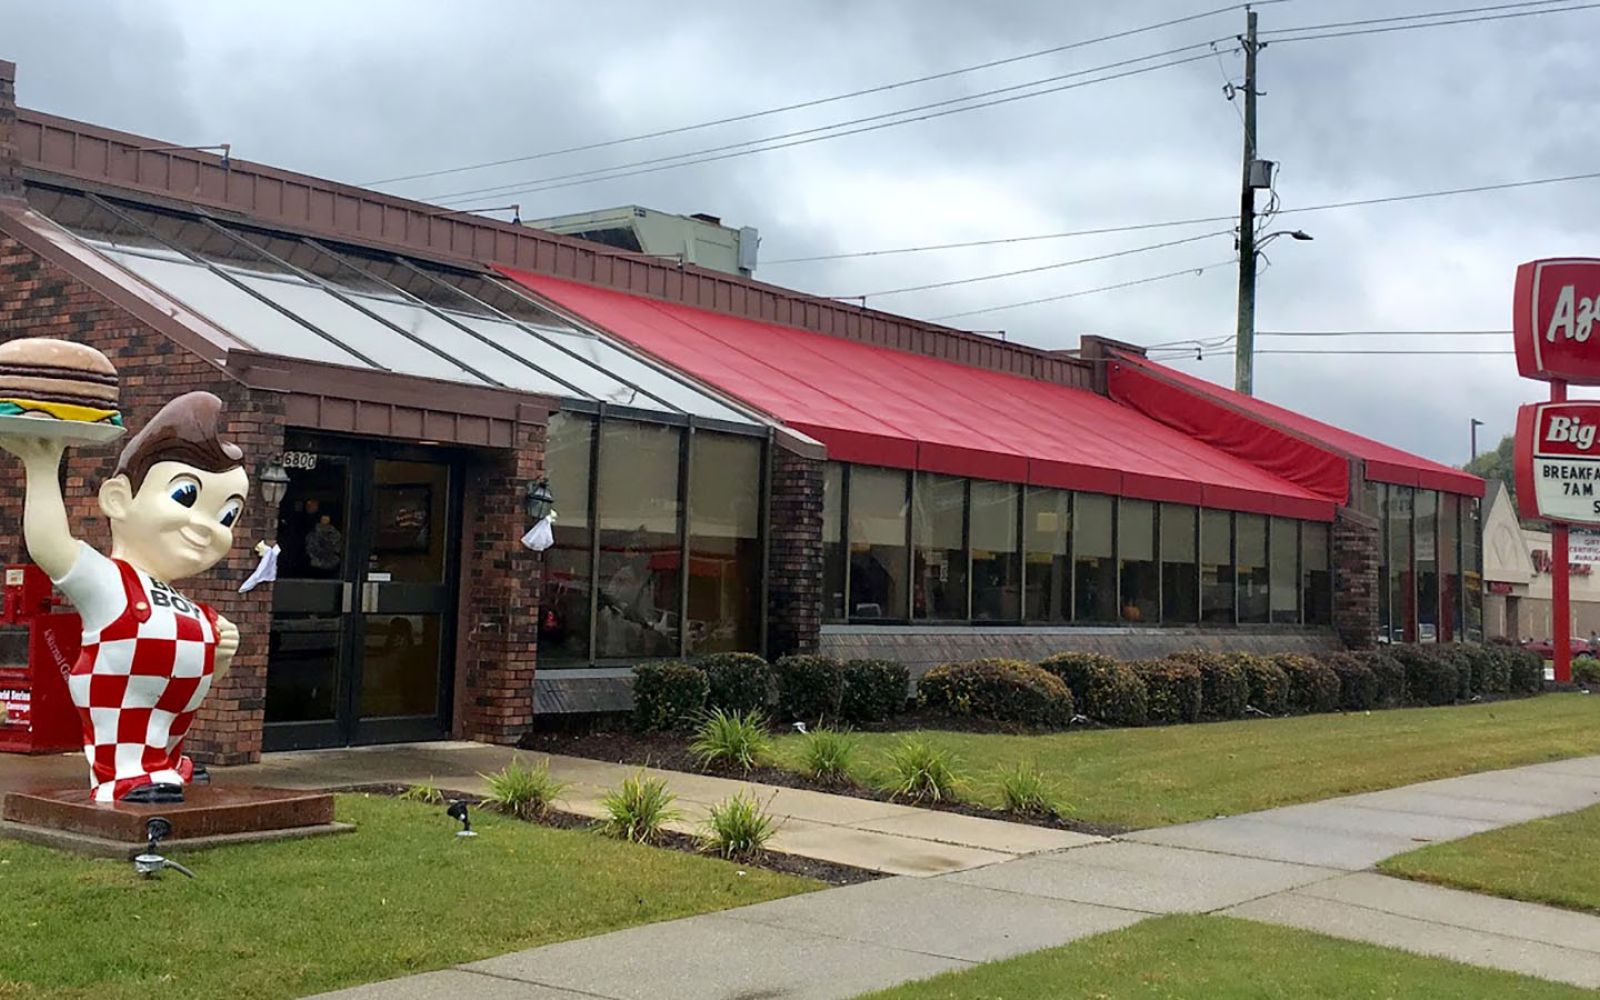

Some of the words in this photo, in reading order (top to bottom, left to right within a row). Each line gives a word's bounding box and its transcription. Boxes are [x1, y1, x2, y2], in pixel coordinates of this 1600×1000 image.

[1546, 284, 1600, 342] Az
[1545, 415, 1597, 450] Big
[284, 452, 316, 469] 6800
[1543, 464, 1600, 480] BREAKFA
[150, 589, 200, 619] BOY
[44, 628, 66, 666] Journal
